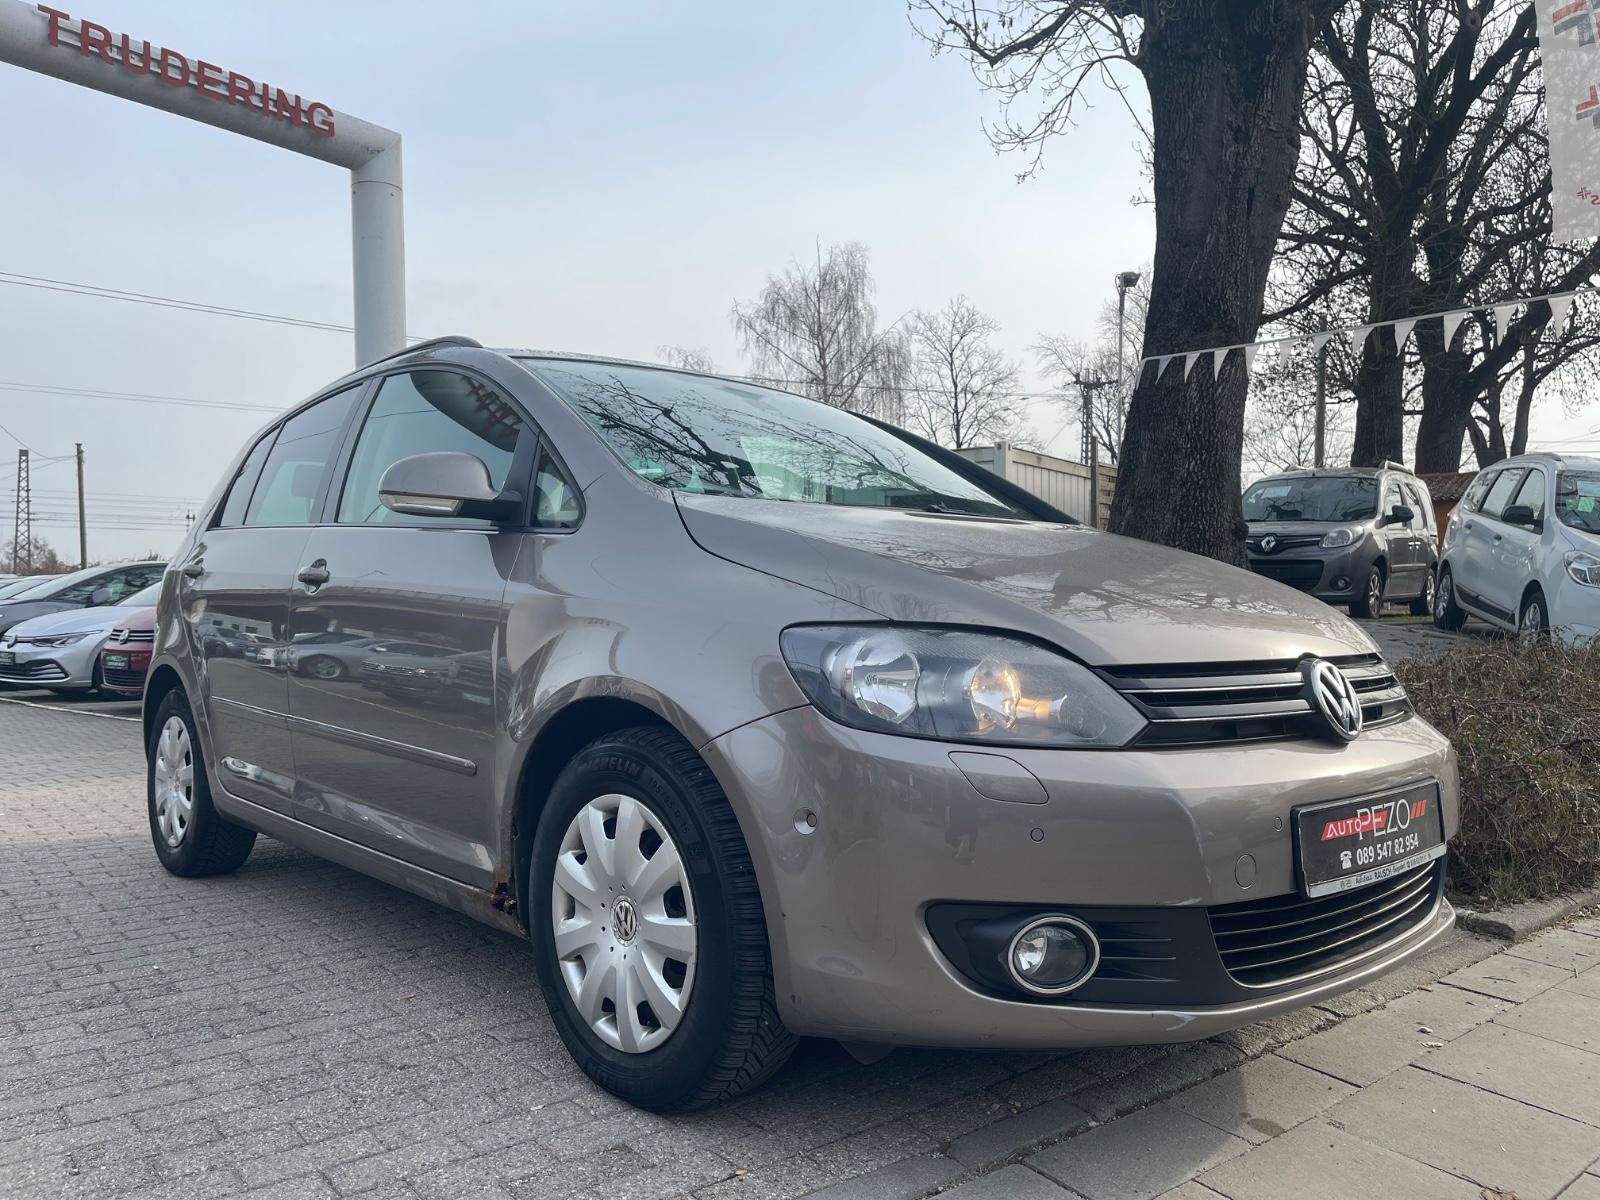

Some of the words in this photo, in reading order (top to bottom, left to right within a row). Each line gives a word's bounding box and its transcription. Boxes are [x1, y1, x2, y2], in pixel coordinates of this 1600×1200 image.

[37, 4, 335, 138] TRUDERING
[1356, 798, 1410, 840] PEZO
[1356, 845, 1375, 865] 089
[1377, 840, 1392, 860] 547
[1394, 837, 1404, 855] 82
[1405, 832, 1419, 851] 954
[1374, 867, 1393, 880] RAUSCH
